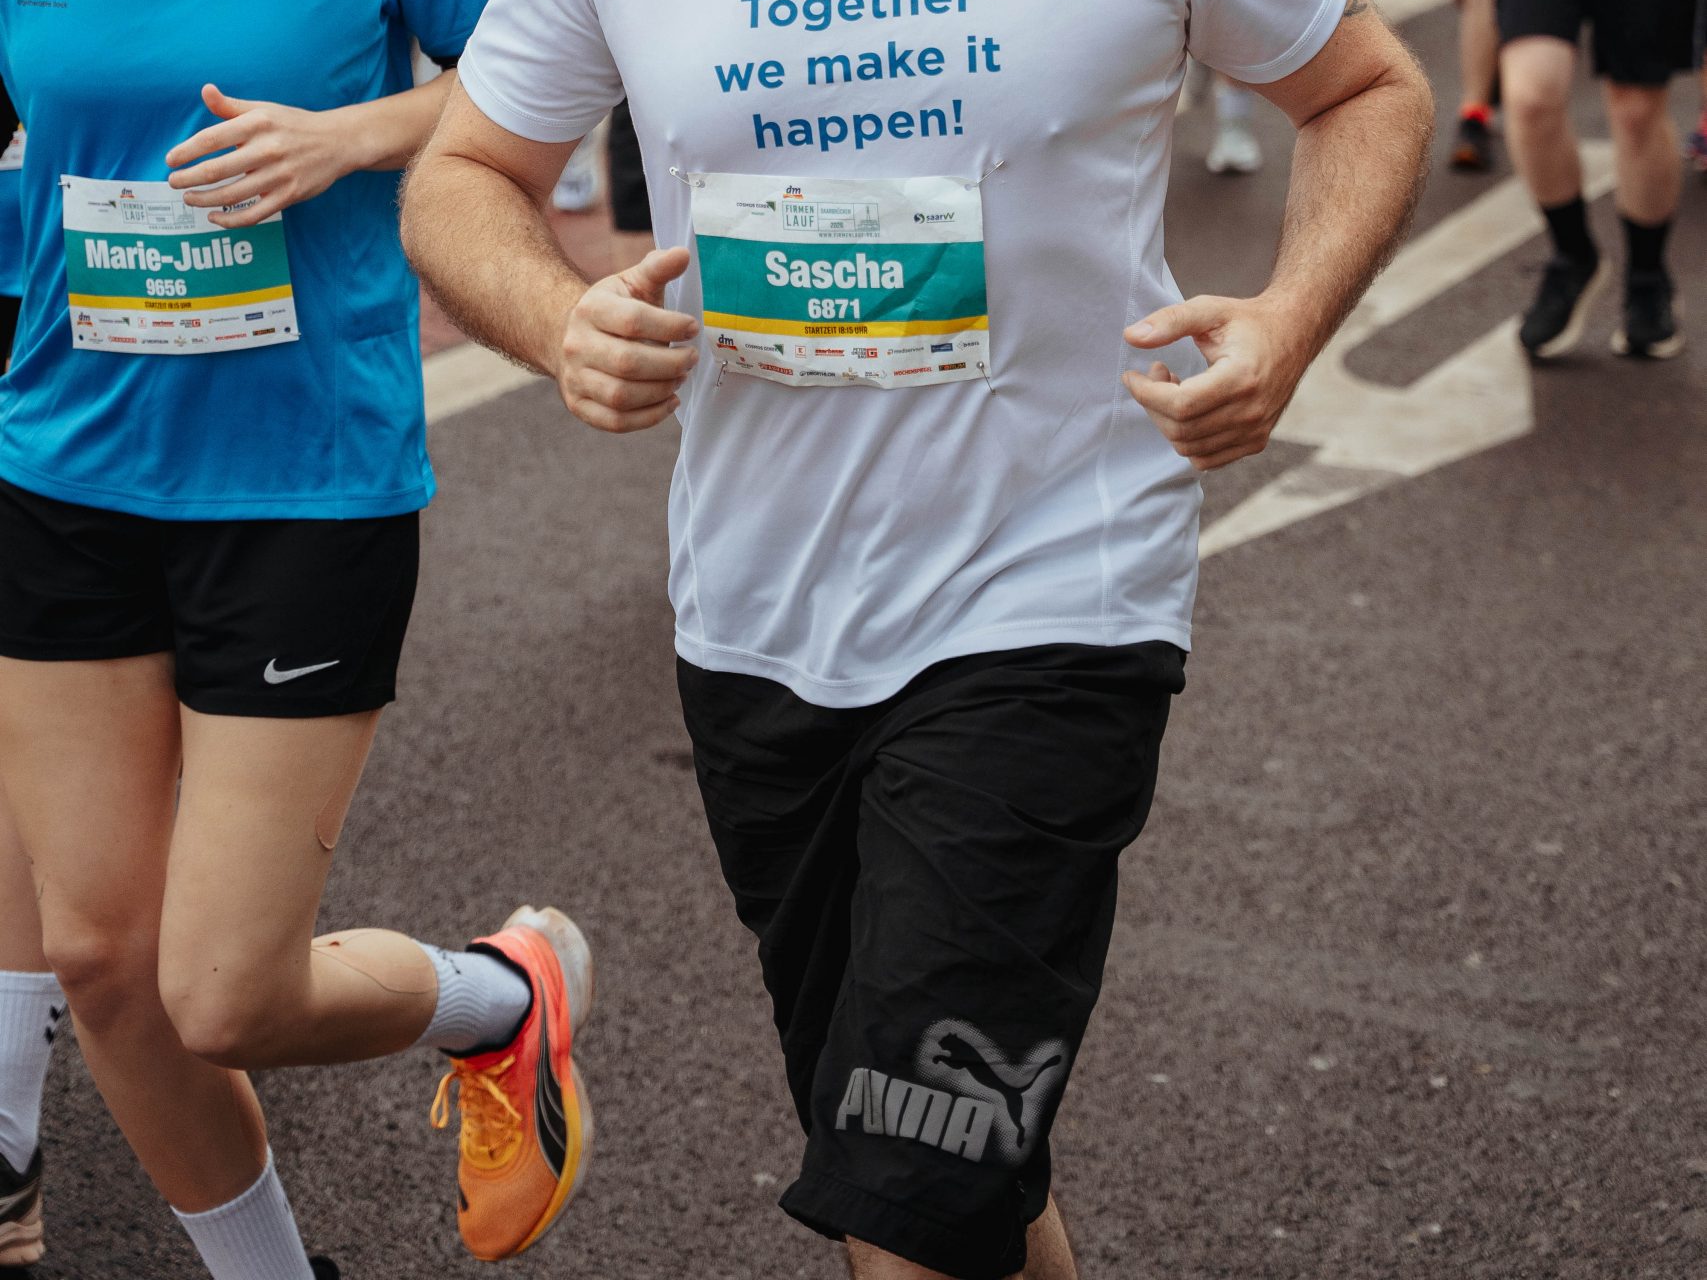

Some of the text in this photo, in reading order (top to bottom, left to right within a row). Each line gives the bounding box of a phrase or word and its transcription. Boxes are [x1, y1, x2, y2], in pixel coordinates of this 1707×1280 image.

[714, 35, 1001, 93] we make it
[753, 99, 963, 152] happen!
[786, 185, 801, 195] dm
[785, 204, 814, 214] FIRMEN
[125, 211, 145, 221] LAUF
[786, 215, 814, 228] LAUF
[84, 237, 254, 272] Marie-Julie
[765, 251, 904, 289] Sascha
[146, 278, 187, 297] 9656
[145, 301, 167, 310] STARTZEIT
[808, 298, 860, 319] 6871
[79, 312, 91, 321] dm
[804, 326, 868, 335] STARTZEIT 18:15 UHR
[718, 334, 734, 345] dm
[893, 366, 933, 376] WOCHENSPIEGEL
[835, 1067, 997, 1163] PUMA
